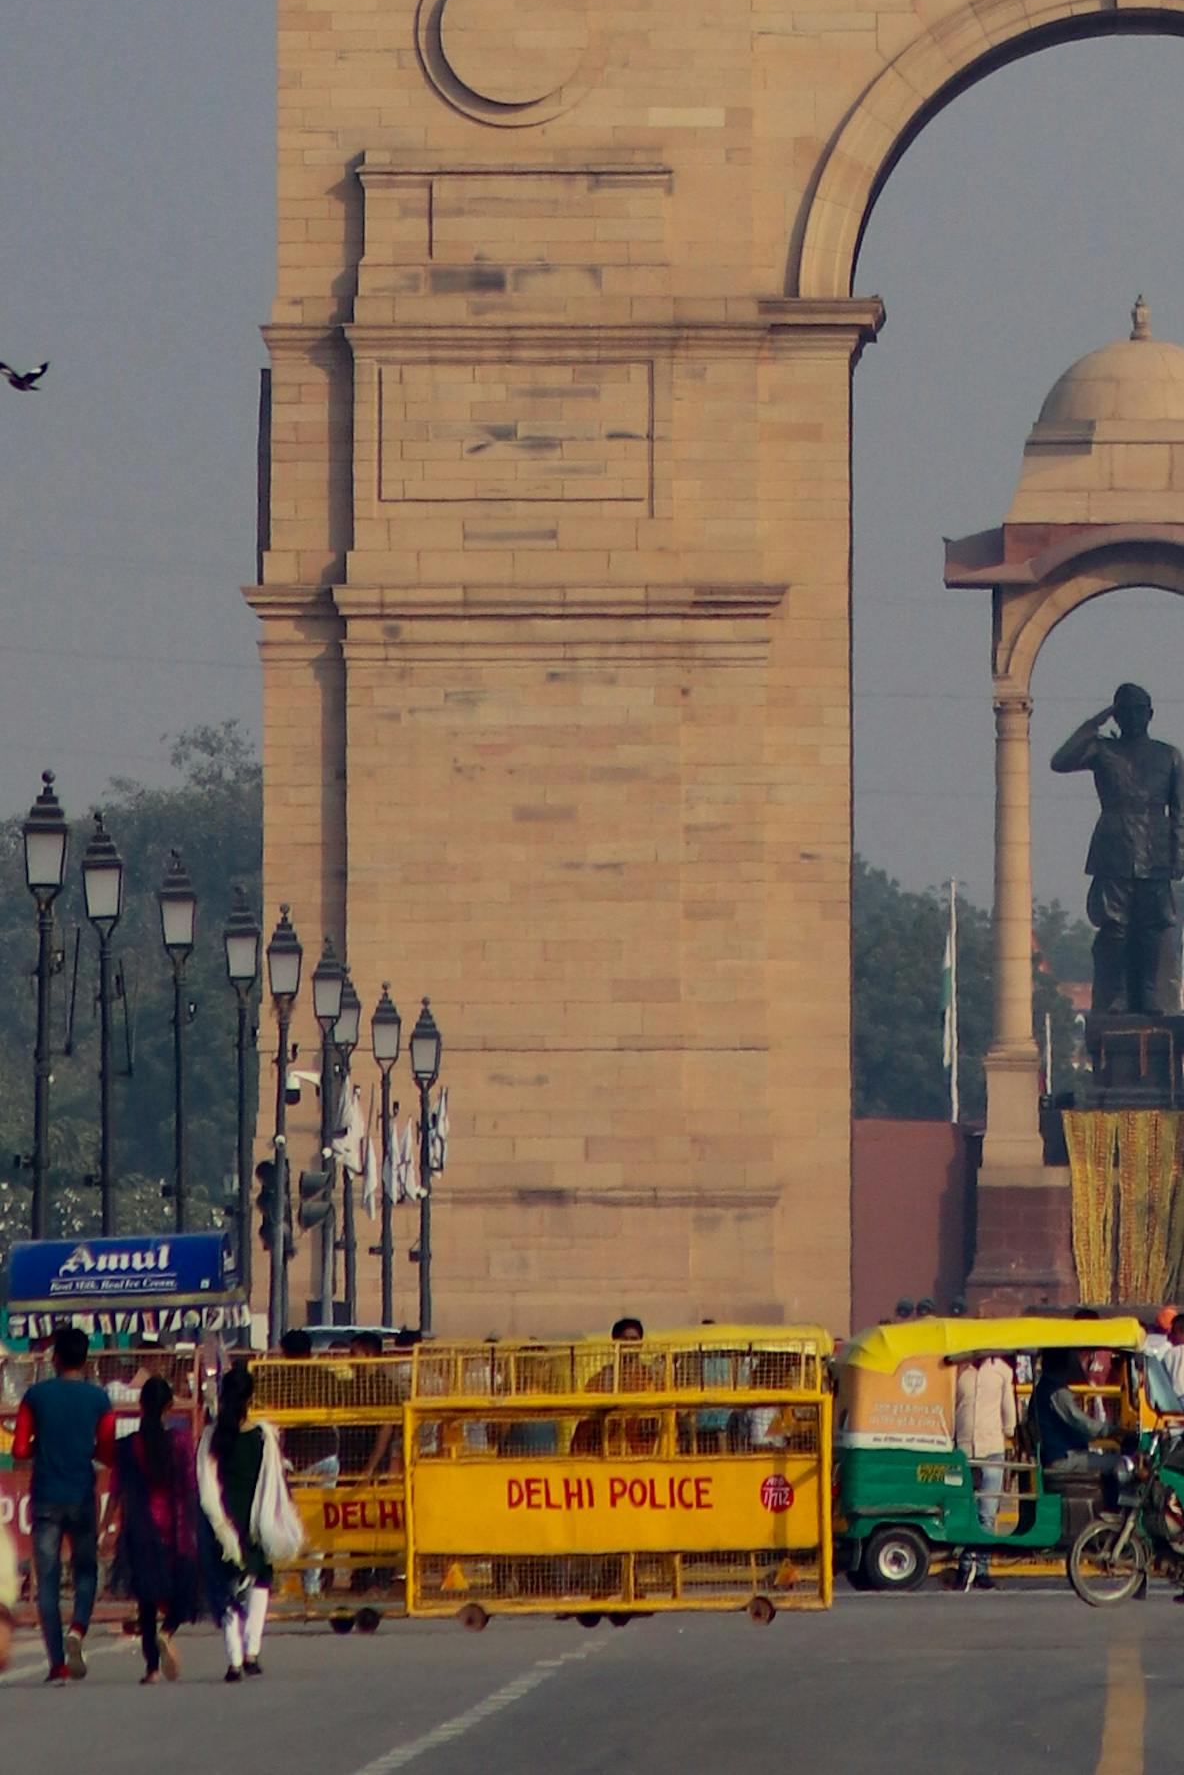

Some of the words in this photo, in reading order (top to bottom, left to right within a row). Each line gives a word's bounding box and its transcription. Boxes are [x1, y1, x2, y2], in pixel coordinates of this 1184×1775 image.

[58, 1242, 171, 1276] Amul
[507, 1478, 595, 1510] DELHI
[608, 1477, 714, 1509] POLICE
